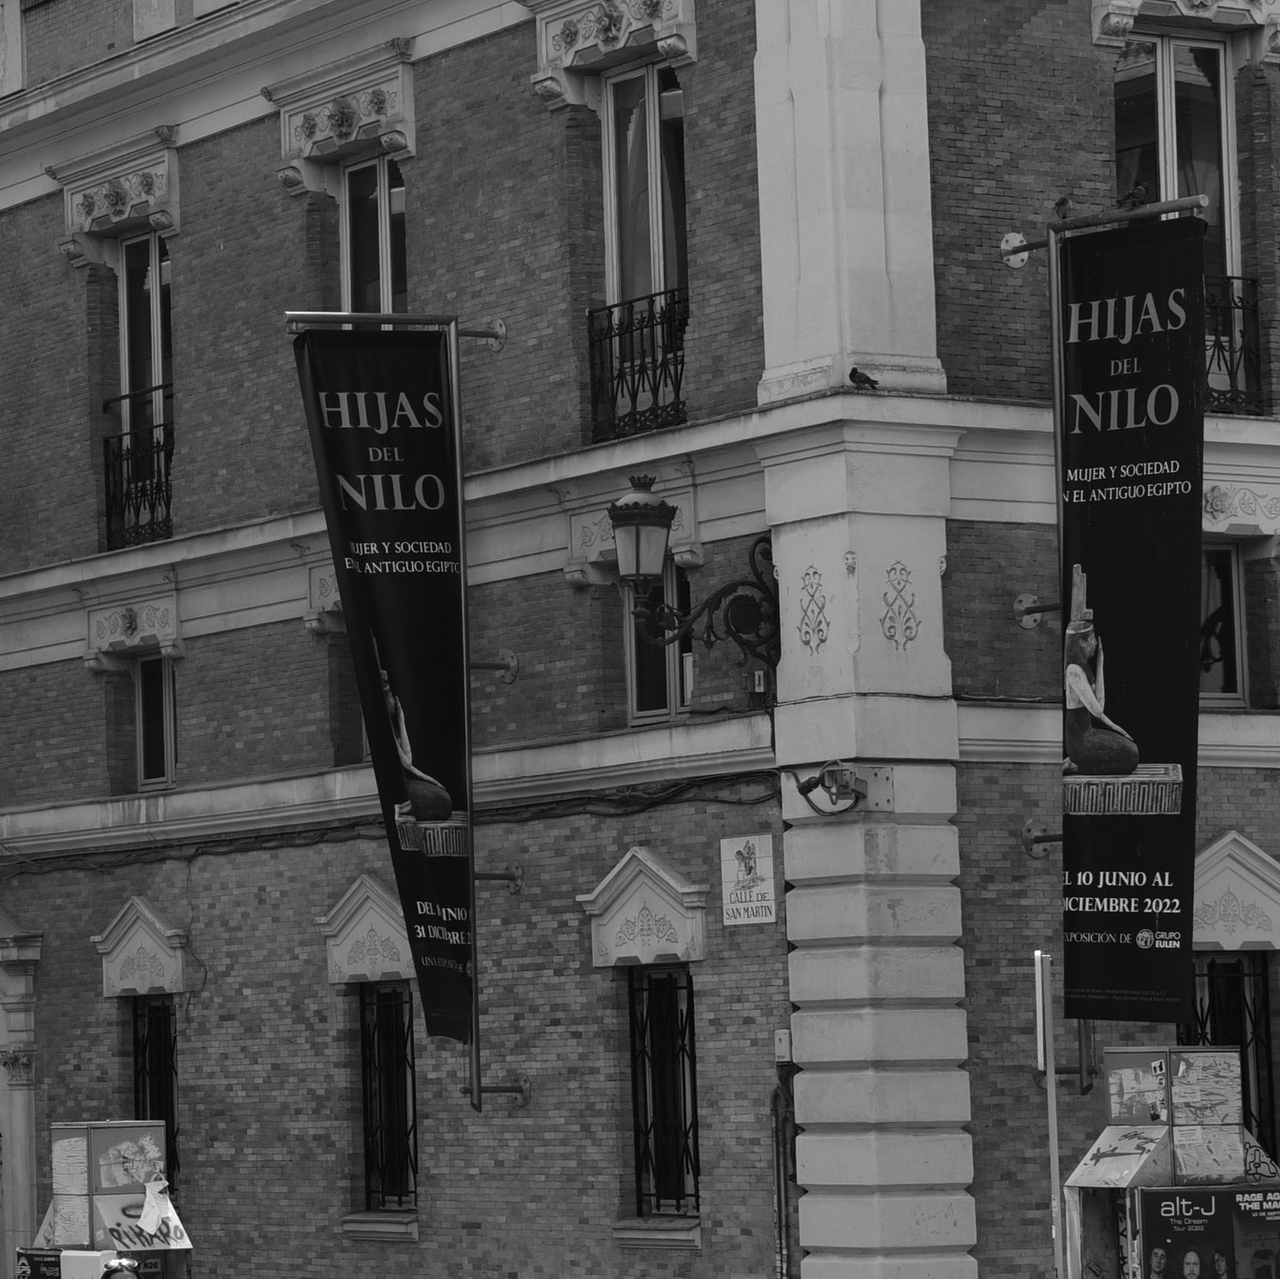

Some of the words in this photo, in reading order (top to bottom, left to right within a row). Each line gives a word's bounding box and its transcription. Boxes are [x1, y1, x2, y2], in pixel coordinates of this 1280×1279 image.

[1066, 287, 1187, 345] HIJAS
[1109, 357, 1142, 377] DEL
[317, 391, 443, 435] HIJAS
[1069, 383, 1180, 434] NILO
[367, 446, 404, 462] DEL
[1066, 465, 1106, 482] MUJER
[1109, 464, 1117, 479] Y
[1120, 460, 1180, 478] SOCIEDAD
[334, 473, 446, 511] NILO
[1072, 489, 1086, 503] EL
[1089, 484, 1145, 502] ANTIGUO
[1147, 480, 1191, 498] EGIPTO
[381, 541, 391, 554] Y
[394, 541, 452, 554] SOCIEDAD
[364, 561, 424, 574] ANTIGUO
[1077, 871, 1093, 886] 10
[1097, 871, 1147, 888] JUNIO
[1152, 872, 1174, 887] AL
[729, 890, 754, 904] CALLE
[756, 891, 770, 902] DE
[1063, 896, 1139, 912] ICIEMBRE
[1143, 898, 1181, 913] 2022
[725, 907, 741, 920] SAN
[743, 905, 773, 919] MARTIN
[414, 924, 426, 938] 31
[1119, 933, 1132, 944] DE
[1154, 931, 1181, 940] GRUPO
[1155, 940, 1180, 949] EULEN
[1235, 1193, 1264, 1202] RAGE
[1160, 1195, 1215, 1217] alt-J
[1238, 1202, 1261, 1211] THE
